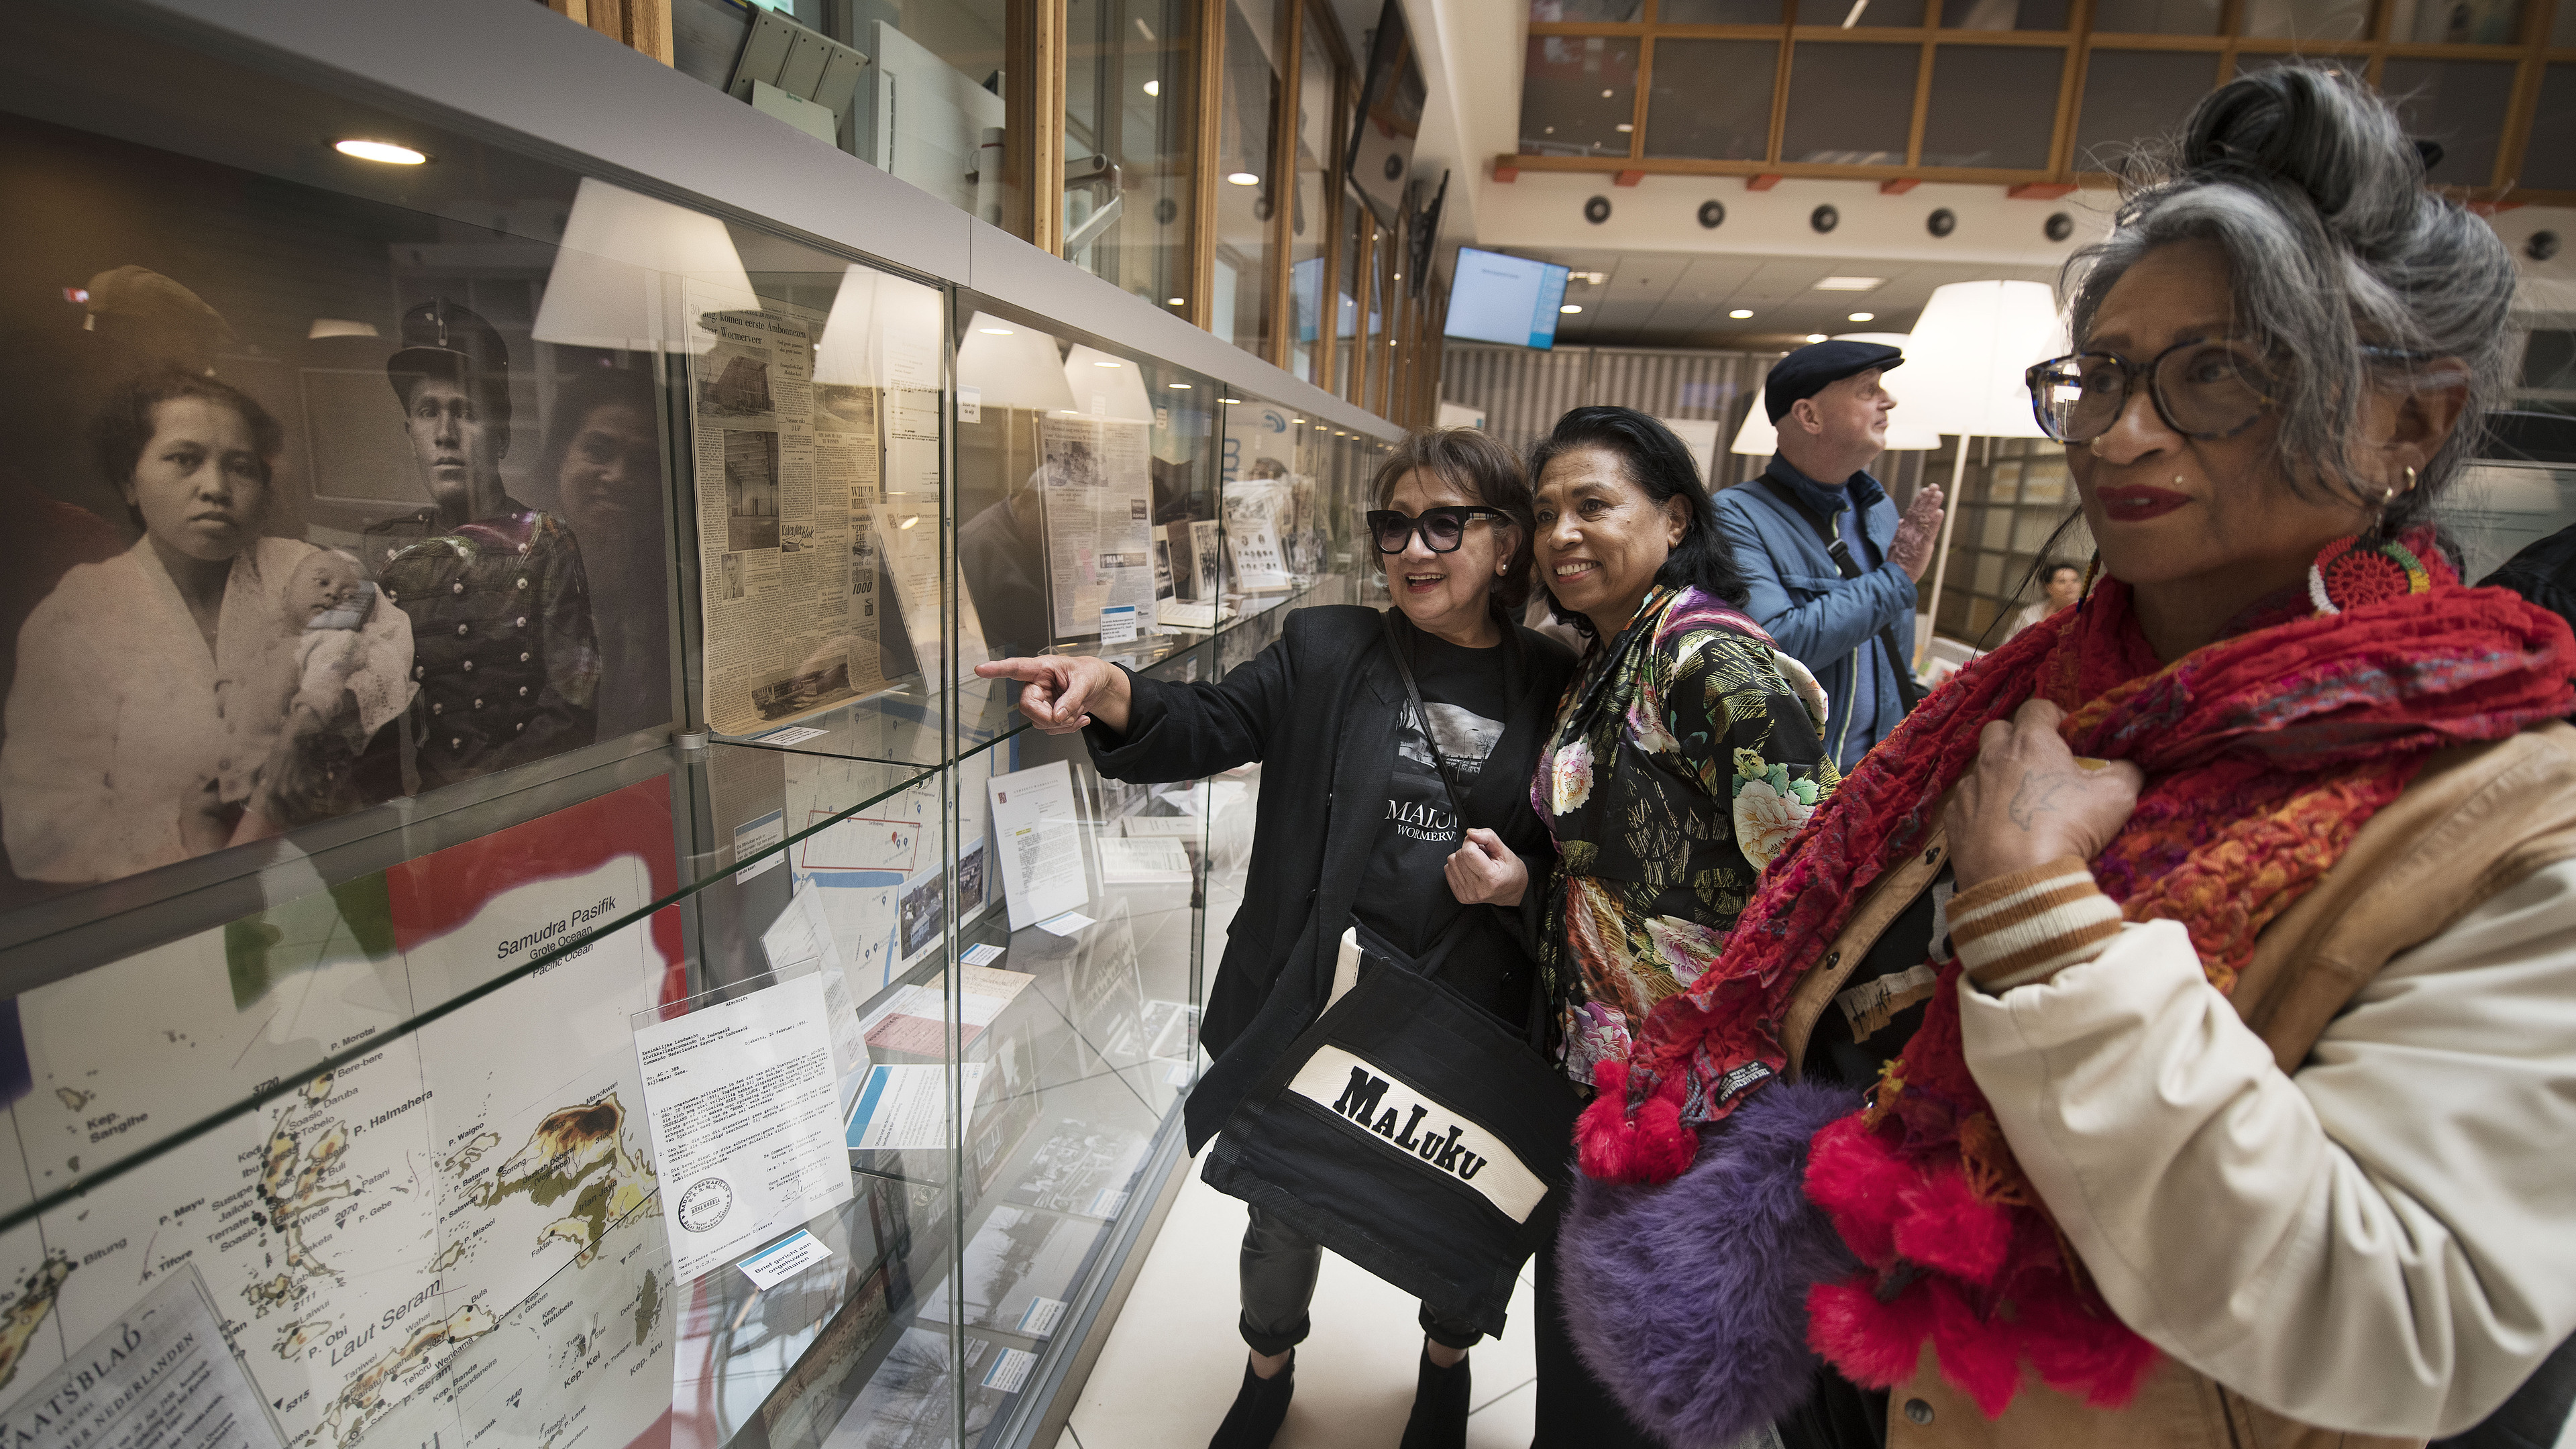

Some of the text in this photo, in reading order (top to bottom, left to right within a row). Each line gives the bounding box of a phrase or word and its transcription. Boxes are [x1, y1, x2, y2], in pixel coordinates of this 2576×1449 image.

[690, 303, 806, 338] 30 aug. komen eerste Ambonnezen
[702, 325, 718, 335] naar
[720, 326, 762, 345] Wormerveer
[855, 533, 865, 541] rit
[1106, 555, 1124, 564] KLM
[851, 568, 873, 584] simca
[853, 581, 872, 595] 1000
[1384, 799, 1458, 829] MALU
[1397, 824, 1456, 842] WORMERV
[497, 896, 616, 959] Samudra Pasifik
[530, 925, 593, 961] Grote Oceaan
[533, 942, 594, 979] Pacific Ocean
[725, 995, 748, 1007] Afschrift
[342, 1025, 376, 1046] Morotai
[641, 1032, 699, 1056] Koninklijke Landmacht
[337, 1051, 384, 1079] Bere-bere
[643, 1054, 666, 1066] Commando
[667, 1042, 698, 1057] Nederlandse
[323, 1086, 360, 1108] Daruba
[586, 1079, 619, 1104] Manokwari
[86, 1112, 120, 1131] Kep.
[353, 1089, 433, 1137] P. Halmahera
[89, 1113, 149, 1144] Sangihe
[300, 1115, 335, 1137] Tobelo
[448, 1121, 485, 1147] P. Waigeo
[237, 1144, 263, 1163] Kedi
[241, 1164, 260, 1179] Ibu
[328, 1161, 347, 1177] Buli
[361, 1167, 391, 1189] Patani
[463, 1166, 490, 1187] Batanta
[501, 1157, 527, 1179] Sorong
[533, 1157, 572, 1187] (Vogelkop)
[211, 1183, 254, 1213] Susupe
[448, 1195, 479, 1219] Salawati
[578, 1179, 618, 1212] Irian Jaya
[173, 1197, 206, 1219] Mayu
[301, 1205, 330, 1225] Weda
[334, 1202, 359, 1222] 2070
[370, 1199, 393, 1217] Gebe
[219, 1226, 258, 1252] Soasio
[464, 1218, 496, 1244] P. Misool
[83, 1237, 129, 1266] Bitung
[531, 1238, 553, 1259] Fakfak
[628, 1243, 643, 1260] 2570
[754, 1242, 812, 1274] Brief gericht aan
[768, 1250, 809, 1274] ongehuwde
[777, 1256, 810, 1276] militairen
[470, 1287, 488, 1305] Bula
[524, 1291, 541, 1306] Kep.
[524, 1291, 549, 1314] Gorom
[298, 1299, 331, 1325] Laiwui
[541, 1305, 558, 1321] Kep.
[542, 1299, 574, 1329] Watubela
[620, 1300, 636, 1318] Dobo
[331, 1279, 441, 1367] Laut Seram
[405, 1311, 431, 1334] Wahai
[594, 1326, 607, 1340] Elat
[308, 1326, 349, 1360] P. Obi
[435, 1336, 474, 1370] Werinama
[343, 1352, 379, 1382] Taniwel
[563, 1350, 602, 1389] Kep. Kei
[629, 1340, 664, 1377] Kep. Aru
[93, 1332, 194, 1428] NEDERLANDEN
[402, 1362, 432, 1387] Tehoru
[417, 1363, 452, 1395] Seram
[432, 1362, 479, 1404] Kep. Banda
[457, 1357, 498, 1395] Bandaneira
[285, 1389, 311, 1413] 5315
[505, 1387, 523, 1407] 7440
[571, 1405, 587, 1422] Larat
[474, 1417, 497, 1440] Manuk
